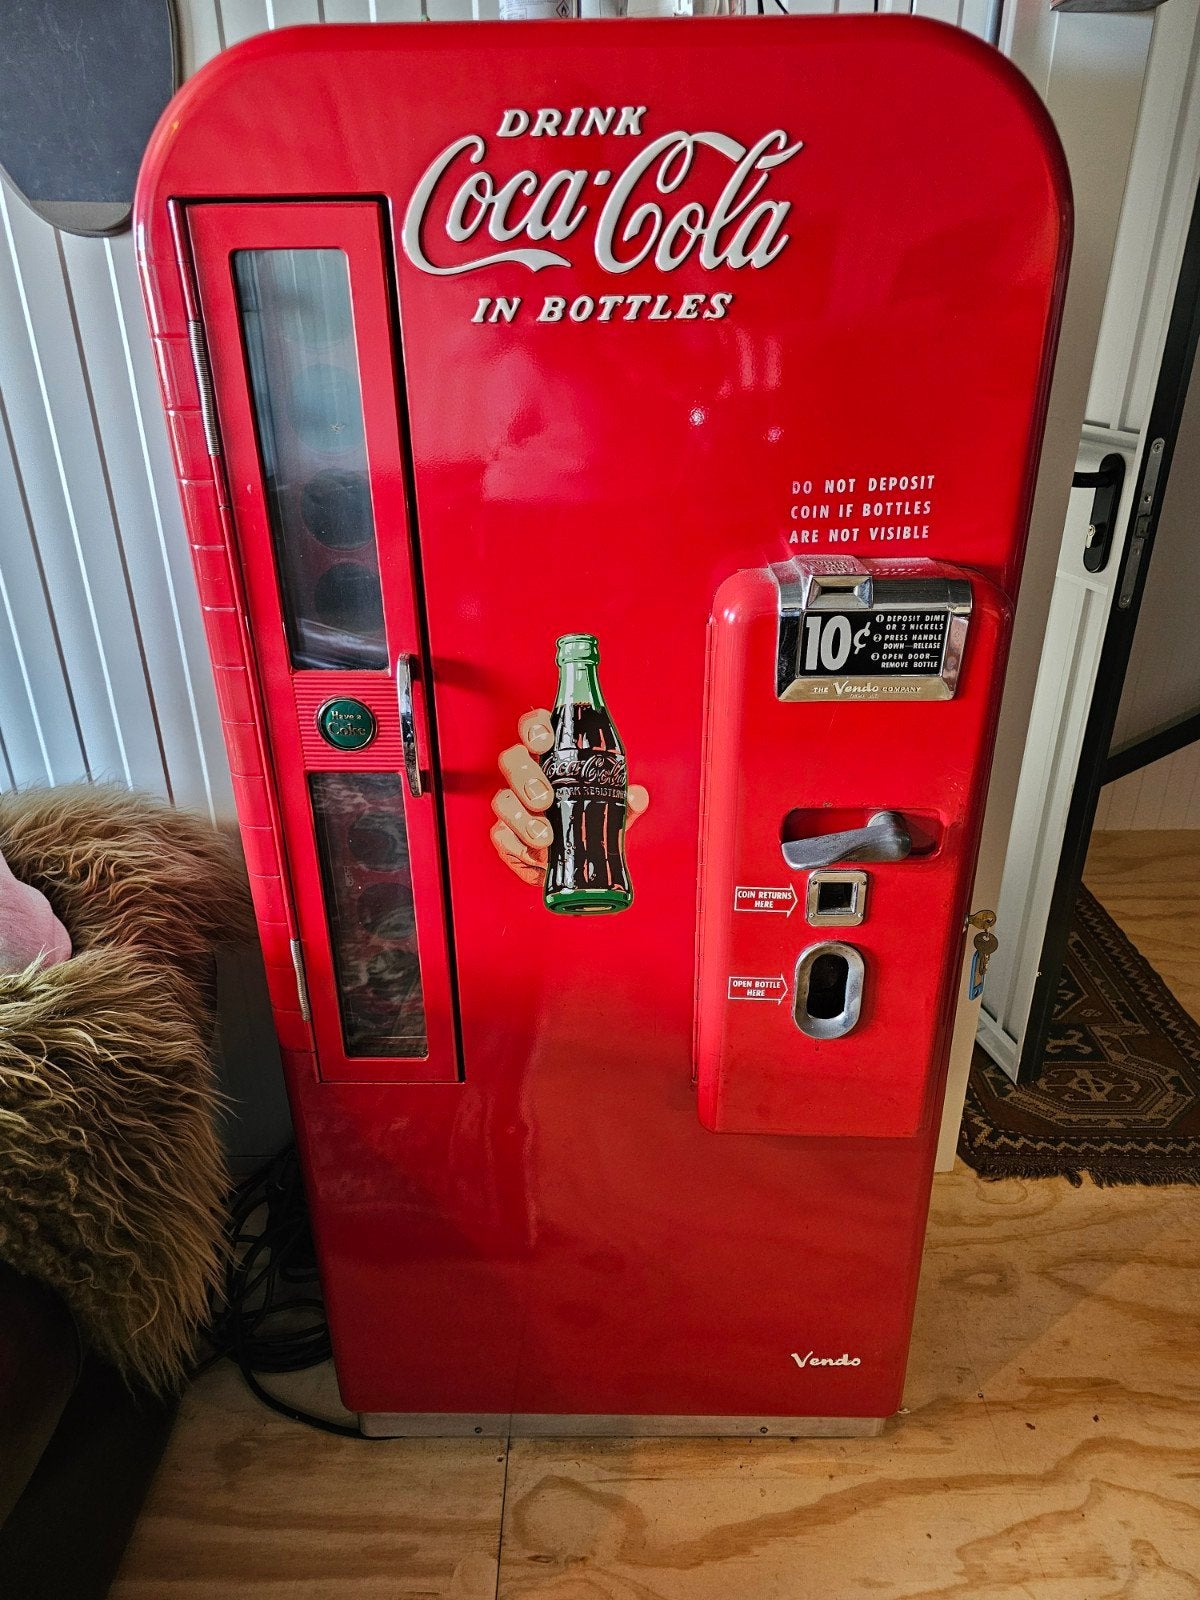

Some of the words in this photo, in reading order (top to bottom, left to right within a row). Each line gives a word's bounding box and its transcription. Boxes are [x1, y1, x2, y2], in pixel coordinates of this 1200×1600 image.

[496, 106, 647, 138] DRINK
[401, 129, 803, 275] Coca-Cola
[471, 297, 521, 323] IN
[537, 292, 733, 323] BOTTLES
[792, 480, 813, 495] DO
[825, 478, 856, 494] NOT
[868, 475, 935, 492] DEPOSIT
[790, 505, 830, 520] COIN
[838, 503, 853, 518] IF
[862, 501, 931, 518] BOTTLES
[789, 530, 819, 544] ARE
[828, 528, 860, 543] NOT
[869, 525, 930, 542] VISIBLE
[925, 614, 945, 622] DIME
[886, 623, 897, 631] OR
[901, 623, 906, 631] 2
[912, 633, 942, 641] HANDLE
[881, 661, 908, 669] REMOVE
[913, 660, 938, 668] BOTTLE
[833, 680, 879, 696] Vendo
[331, 710, 354, 720] Have
[327, 721, 366, 736] Coke
[737, 890, 756, 899] COIN
[758, 890, 792, 900] RETURNS
[754, 900, 774, 909] HERE
[732, 980, 752, 988] OPEN
[755, 980, 781, 989] BOTTLE
[746, 989, 766, 997] HERE
[790, 1350, 861, 1368] Vendo
